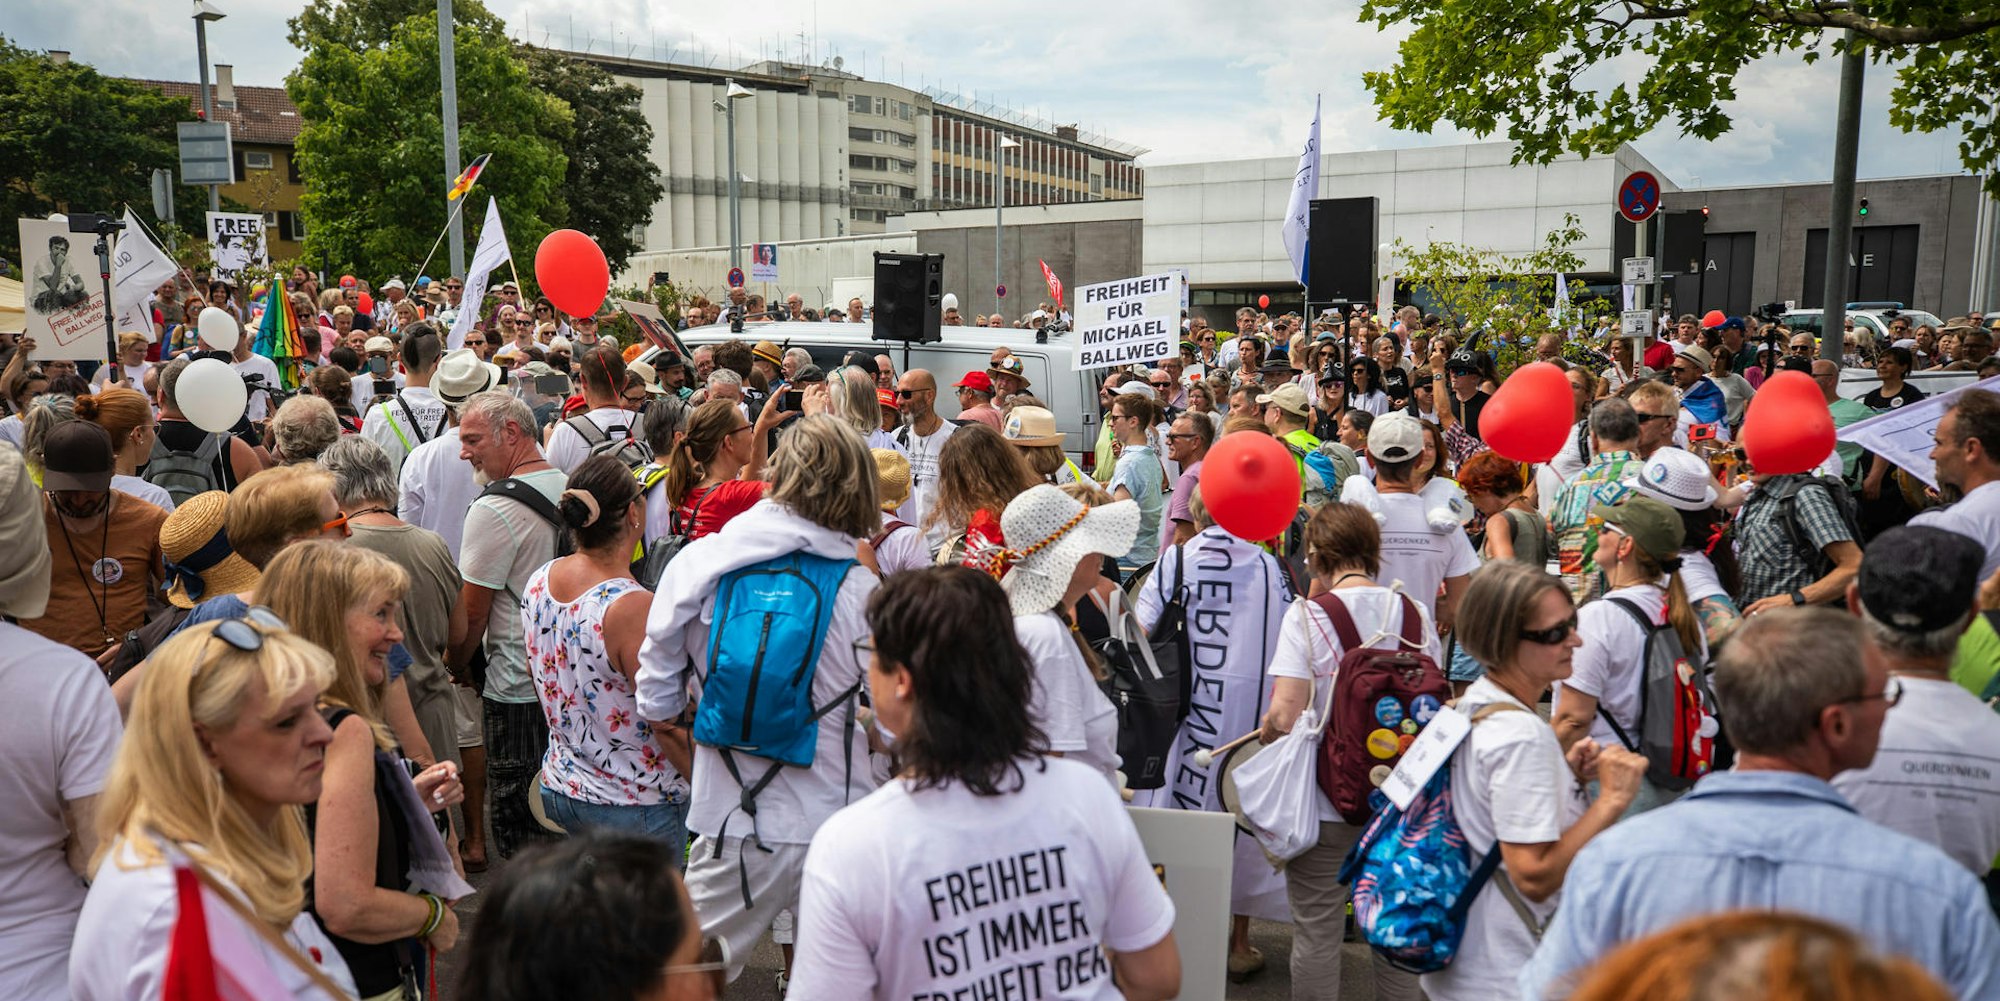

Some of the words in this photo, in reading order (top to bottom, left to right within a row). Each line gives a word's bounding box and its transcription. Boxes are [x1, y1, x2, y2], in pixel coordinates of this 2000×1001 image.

[214, 218, 258, 233] FREE
[1086, 276, 1170, 303] FREIHEIT
[52, 316, 73, 330] FREE
[73, 299, 106, 321] MICHAEL
[65, 312, 103, 335] BALLWEG
[1107, 301, 1143, 321] FÜR
[1083, 320, 1166, 345] MICHAEL
[1080, 342, 1169, 366] BALLWEG
[924, 845, 1067, 923] FREIHEIT
[922, 927, 971, 979] IST
[979, 900, 1090, 962] IMMER
[1055, 944, 1107, 993] DER
